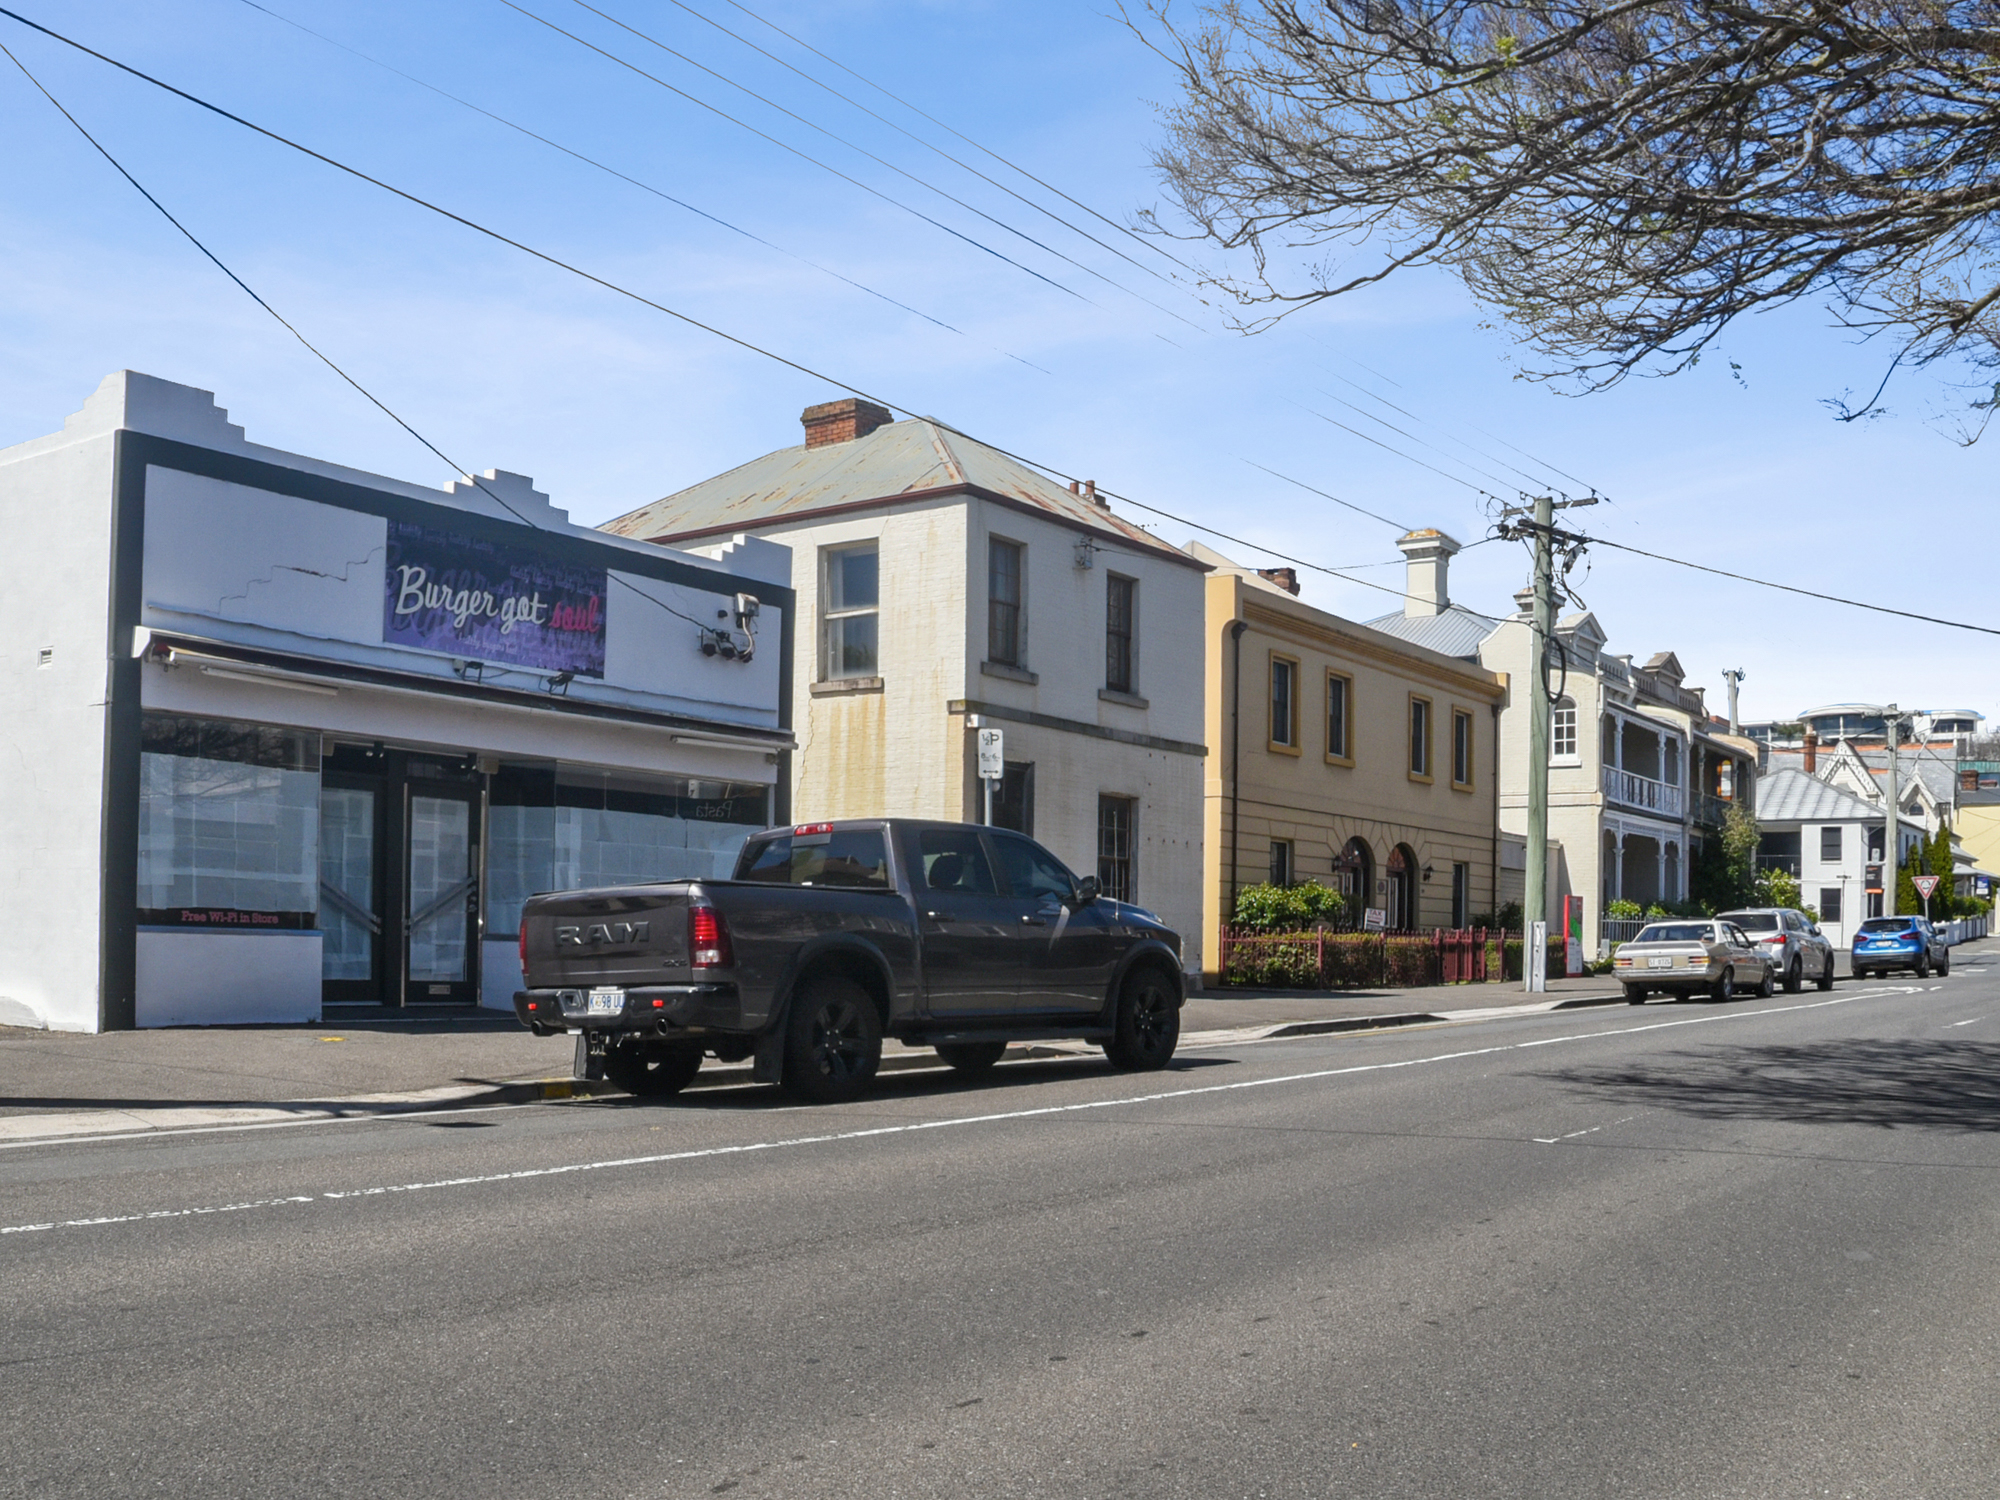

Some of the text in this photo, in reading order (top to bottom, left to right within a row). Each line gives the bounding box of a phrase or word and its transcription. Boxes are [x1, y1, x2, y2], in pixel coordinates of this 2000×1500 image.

[395, 565, 499, 629] Burger
[500, 592, 547, 635] got
[549, 595, 600, 633] soul
[181, 910, 279, 924] Free Wi-Fi in Store
[554, 920, 650, 947] RAM
